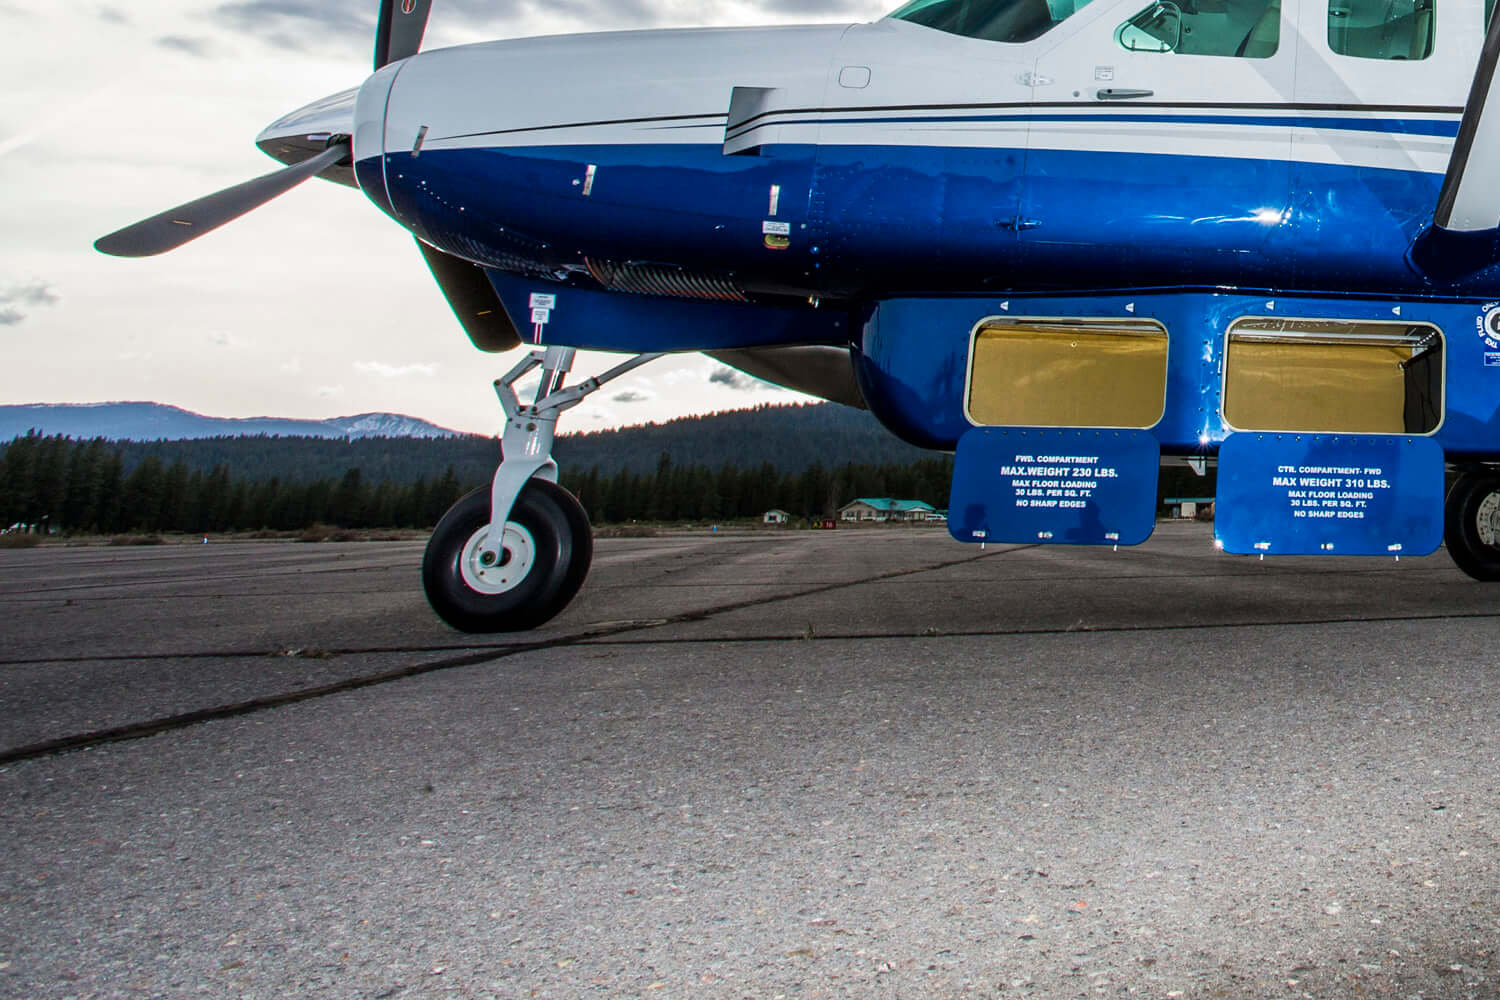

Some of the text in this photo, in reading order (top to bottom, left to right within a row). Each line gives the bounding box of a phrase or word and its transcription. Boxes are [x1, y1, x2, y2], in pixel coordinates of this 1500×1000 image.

[1477, 316, 1486, 337] FLUID
[1485, 337, 1498, 349] TKS
[1015, 455, 1099, 464] FWD. COMPARTMENT
[1072, 468, 1092, 477] 230
[1094, 468, 1118, 478] LBS.
[1277, 465, 1297, 473] CTR.
[1011, 479, 1097, 489] MAX FLOOR LOADING
[1272, 477, 1391, 488] MAX WEIGHT 310 LBS.
[1015, 488, 1025, 496] 30
[1046, 489, 1063, 497] PER
[1288, 490, 1374, 499] MAX FLOOR LOADING
[1016, 499, 1086, 508] NO SHARP EDGES
[1290, 499, 1300, 507] 30
[1339, 500, 1354, 508] SQ.
[1355, 500, 1367, 508] FT.
[1294, 510, 1306, 518] NO
[1337, 511, 1364, 519] EDGES
